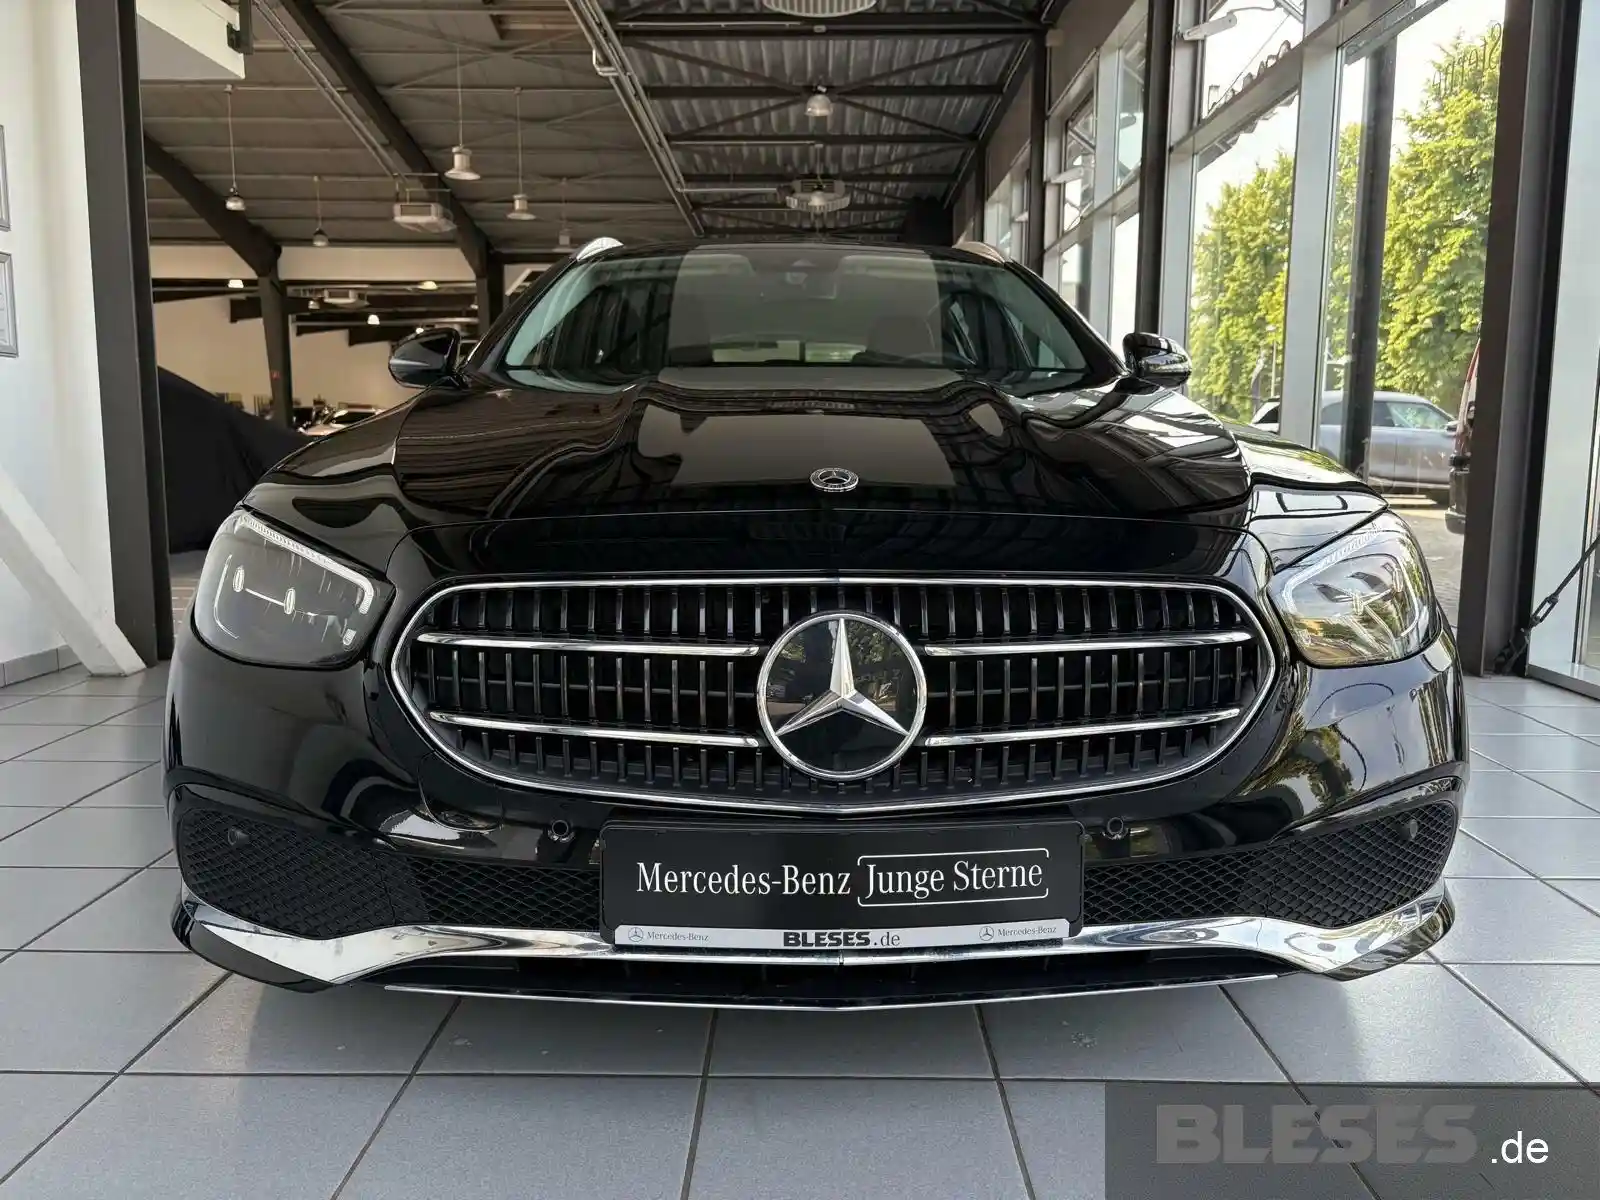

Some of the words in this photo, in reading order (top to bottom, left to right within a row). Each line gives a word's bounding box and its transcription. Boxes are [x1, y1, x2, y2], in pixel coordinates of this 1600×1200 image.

[636, 862, 851, 895] Mercedes-Benz
[865, 864, 944, 899] Junge
[953, 860, 1042, 891] Sterne
[647, 931, 709, 942] Mercedes-Benz
[997, 926, 1057, 937] Mercedes-Benz
